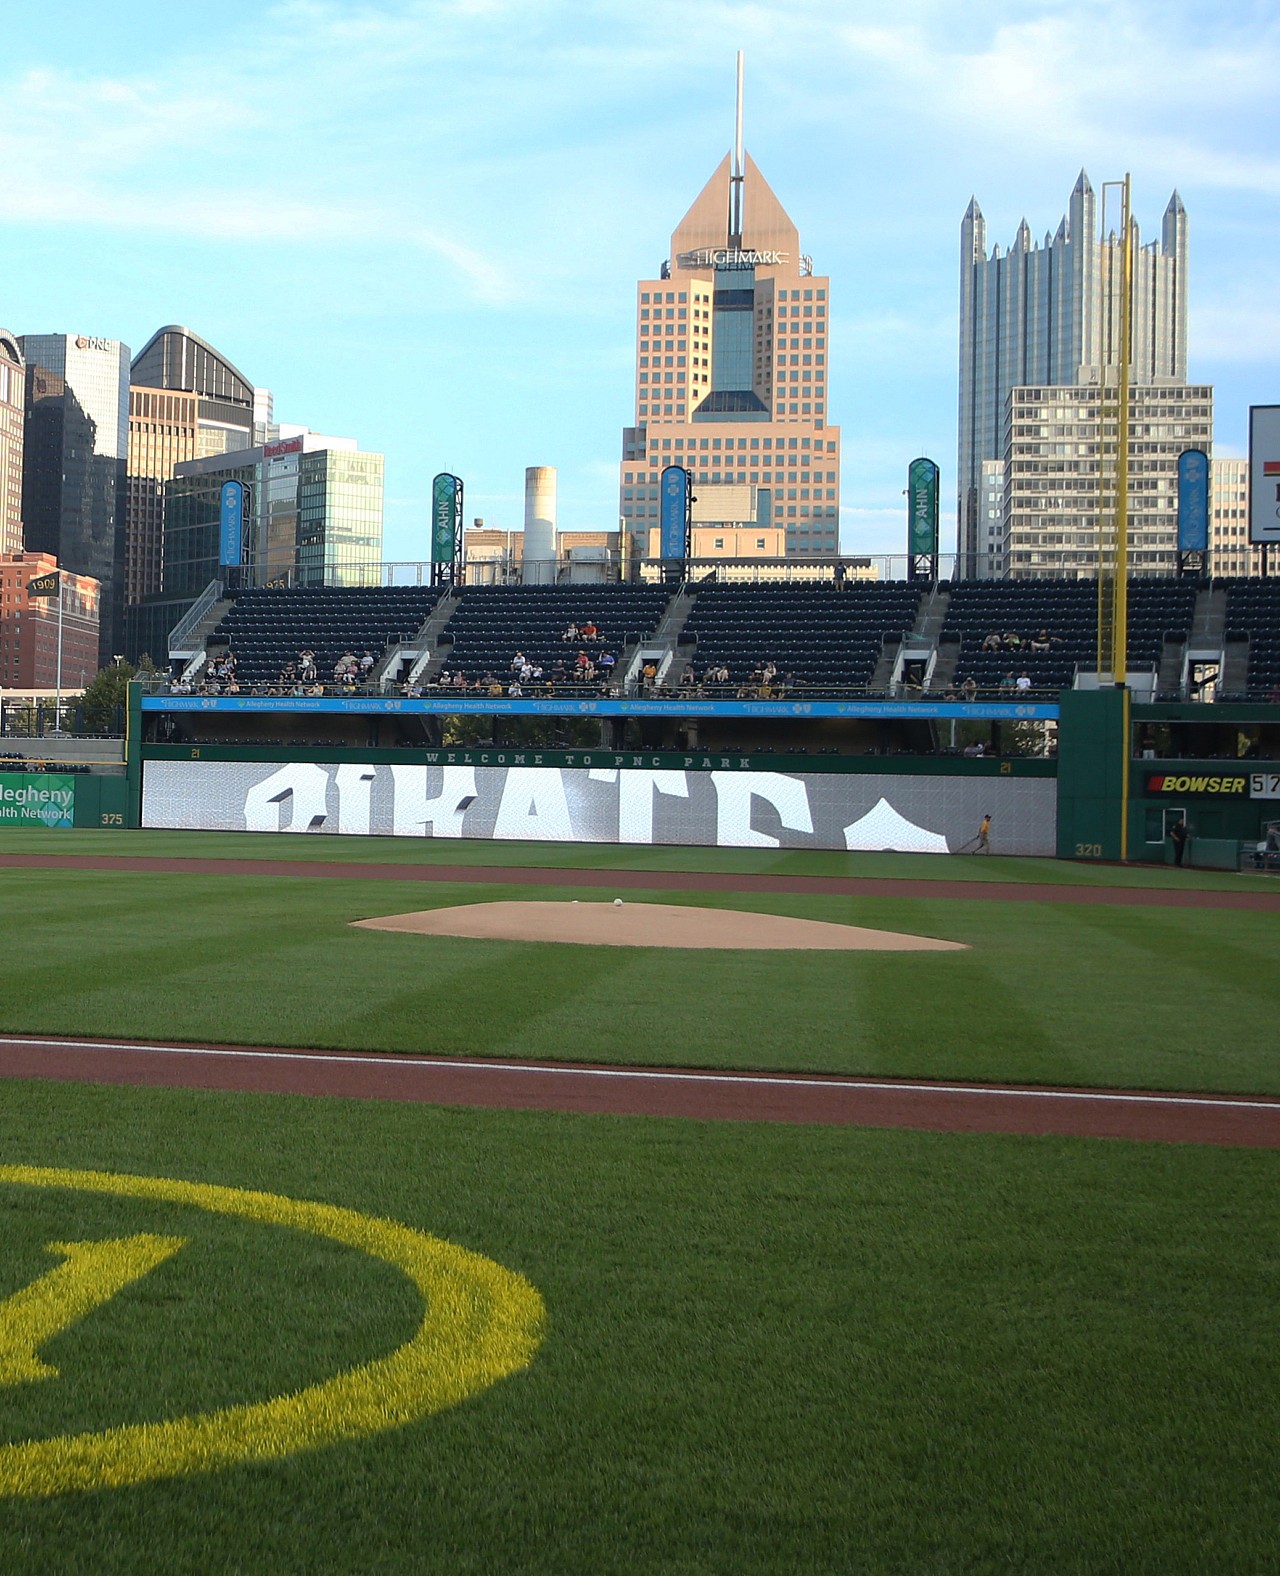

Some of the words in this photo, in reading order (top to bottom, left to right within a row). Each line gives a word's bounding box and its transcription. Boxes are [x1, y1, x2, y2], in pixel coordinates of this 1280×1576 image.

[696, 247, 789, 265] HIGHMARK
[916, 489, 928, 518] AHN
[439, 501, 449, 528] AHN
[32, 579, 56, 590] 1909
[191, 748, 200, 758] 21
[426, 753, 543, 765] WELCOME
[565, 755, 592, 765] TO
[614, 756, 661, 767] PNC
[684, 757, 750, 768] PARK
[1000, 762, 1011, 773] 21
[1161, 776, 1246, 793] BOWSER
[21, 808, 70, 820] Network
[101, 813, 123, 825] 375
[1075, 843, 1102, 857] 320
